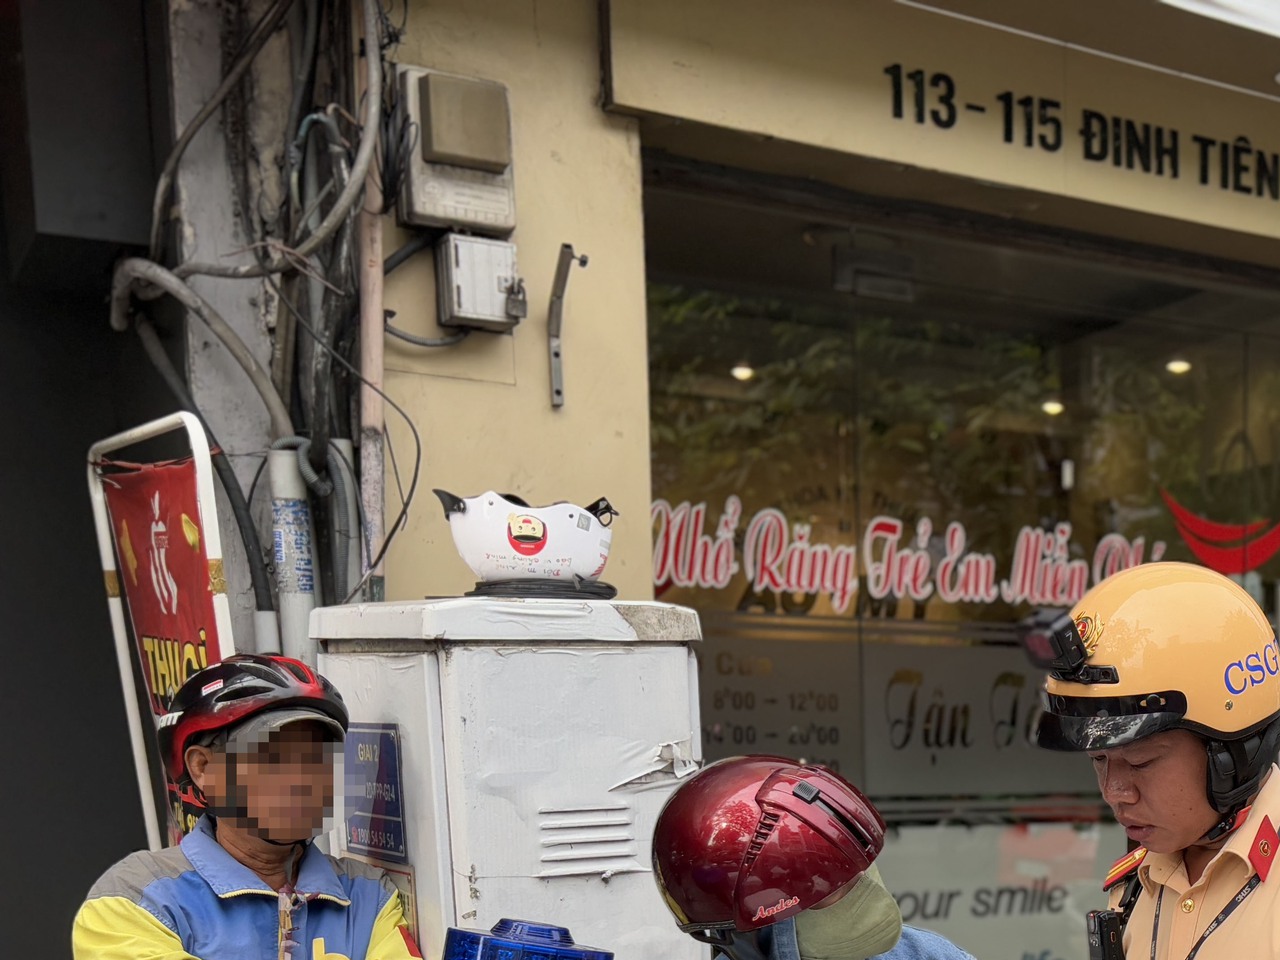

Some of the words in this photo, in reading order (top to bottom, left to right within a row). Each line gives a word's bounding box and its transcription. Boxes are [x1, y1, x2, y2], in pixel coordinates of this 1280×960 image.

[1079, 108, 1179, 179] ĐINH
[1192, 135, 1280, 200] TIÊN
[744, 507, 859, 614] Răng
[864, 515, 933, 600] Trẻ
[936, 521, 999, 603] Em
[752, 896, 801, 921] Andes
[893, 887, 962, 922] our
[970, 876, 1069, 918] smile
